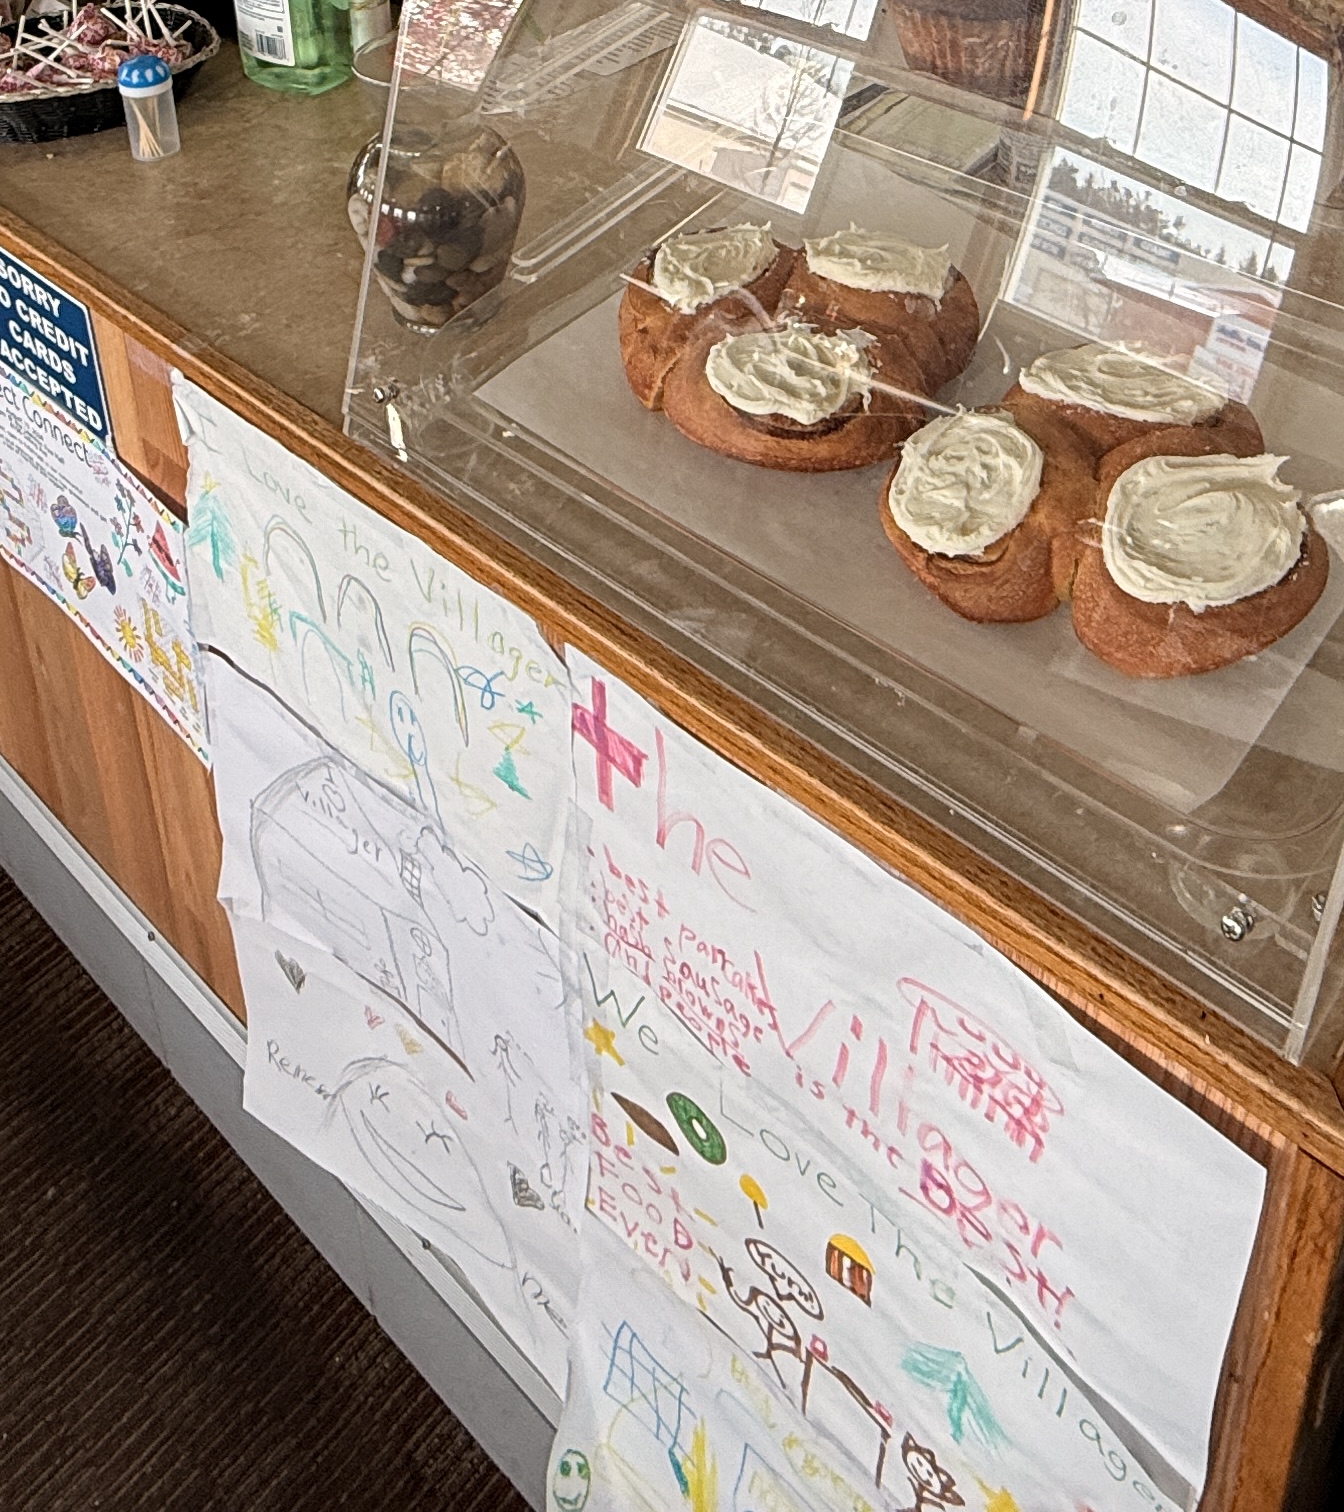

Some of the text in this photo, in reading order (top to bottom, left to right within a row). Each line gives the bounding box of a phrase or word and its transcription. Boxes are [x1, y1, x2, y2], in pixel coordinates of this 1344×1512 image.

[8, 320, 77, 384] CARDS
[15, 299, 89, 367] CREDIT
[0, 338, 103, 432] ACCEPTED
[21, 395, 93, 469] Connect
[337, 515, 392, 583] the
[410, 557, 568, 688] Villager
[582, 951, 660, 1056] We
[719, 1068, 844, 1207] Love
[858, 1192, 957, 1310] The
[795, 1063, 826, 1100] is
[842, 1100, 905, 1170] the
